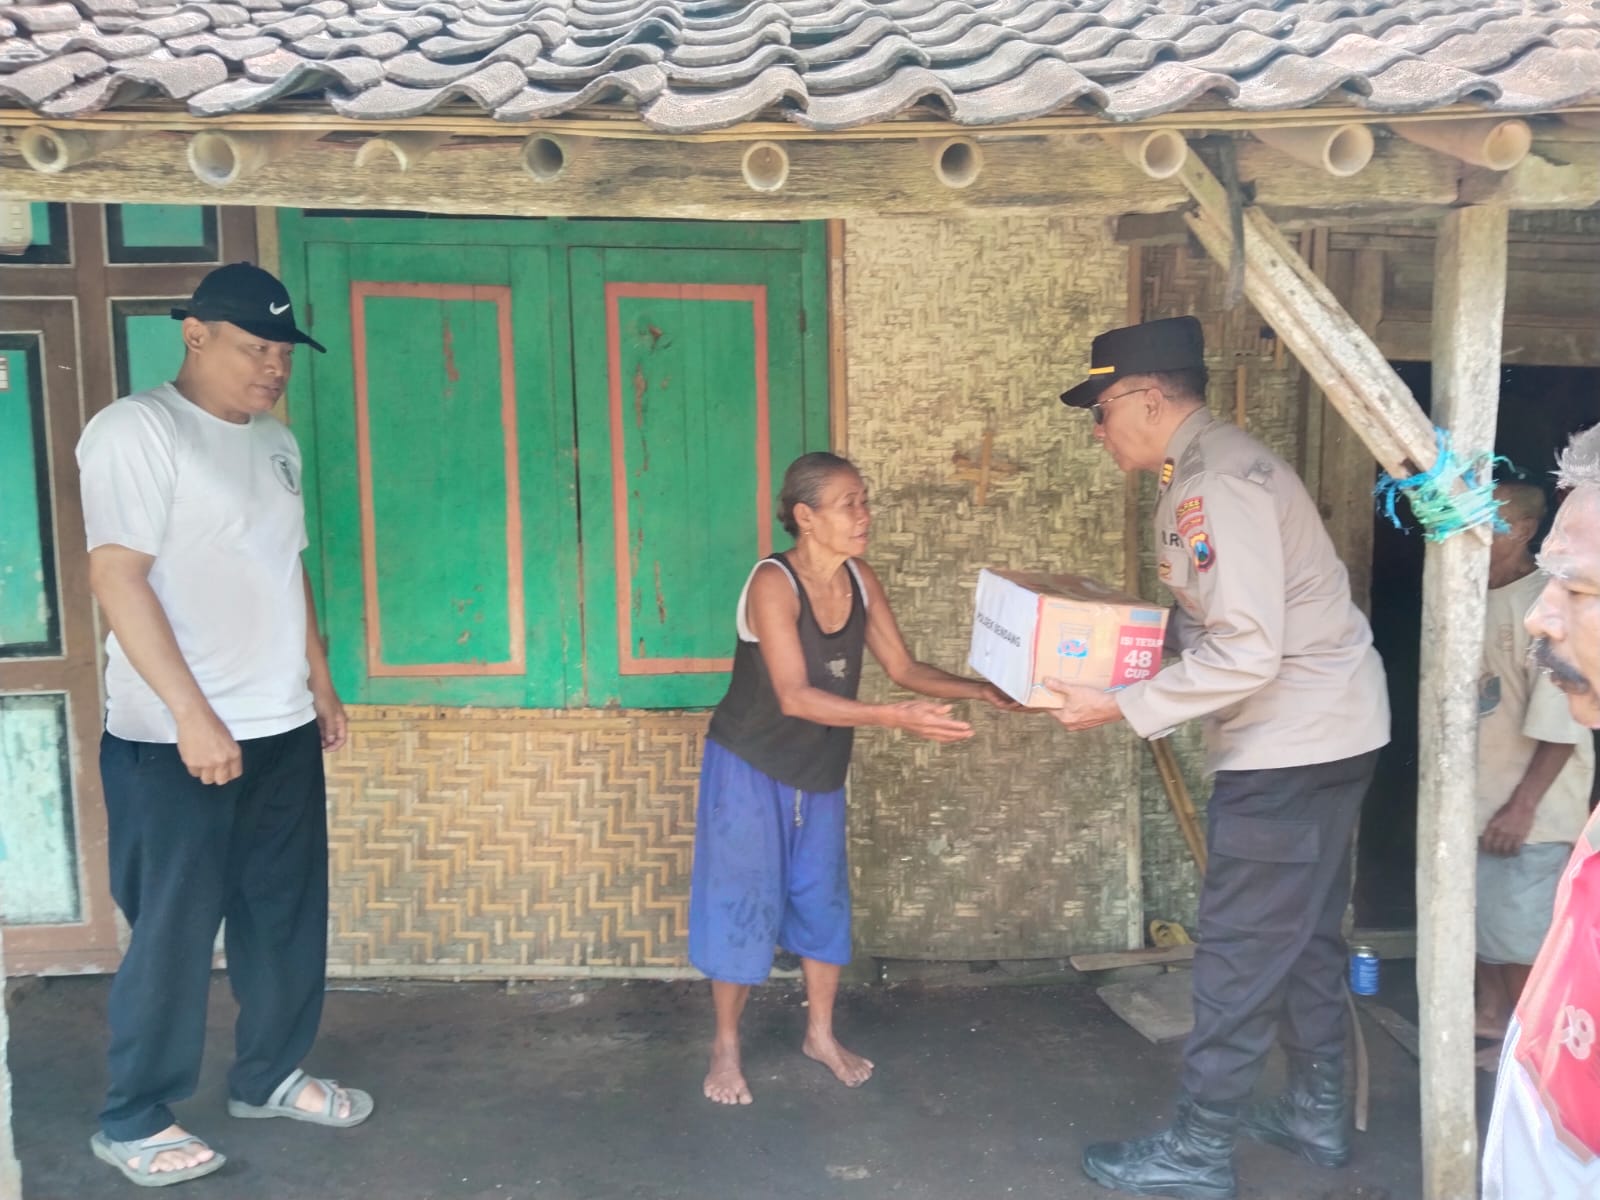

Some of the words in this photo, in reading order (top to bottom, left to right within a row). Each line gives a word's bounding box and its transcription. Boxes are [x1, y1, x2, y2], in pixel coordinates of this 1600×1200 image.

[1119, 636, 1134, 646] ISI
[1135, 637, 1164, 648] TETAP
[1123, 649, 1153, 668] 48
[1124, 667, 1151, 679] CUP
